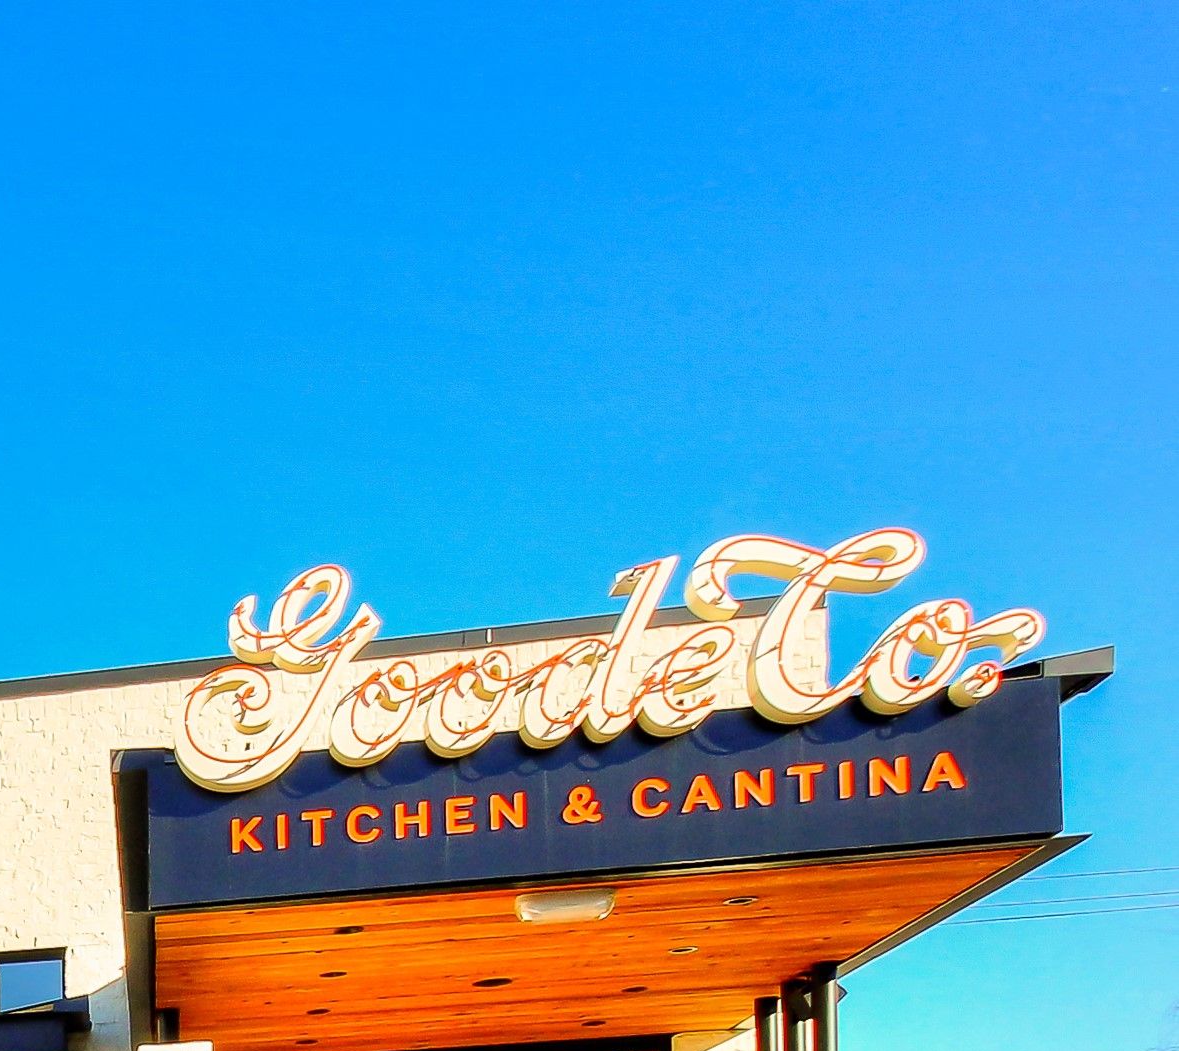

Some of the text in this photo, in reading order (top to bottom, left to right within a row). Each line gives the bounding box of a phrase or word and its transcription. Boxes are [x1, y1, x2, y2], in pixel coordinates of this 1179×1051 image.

[174, 554, 736, 794] Goode
[227, 750, 969, 855] KITCHEN & CANTINA
